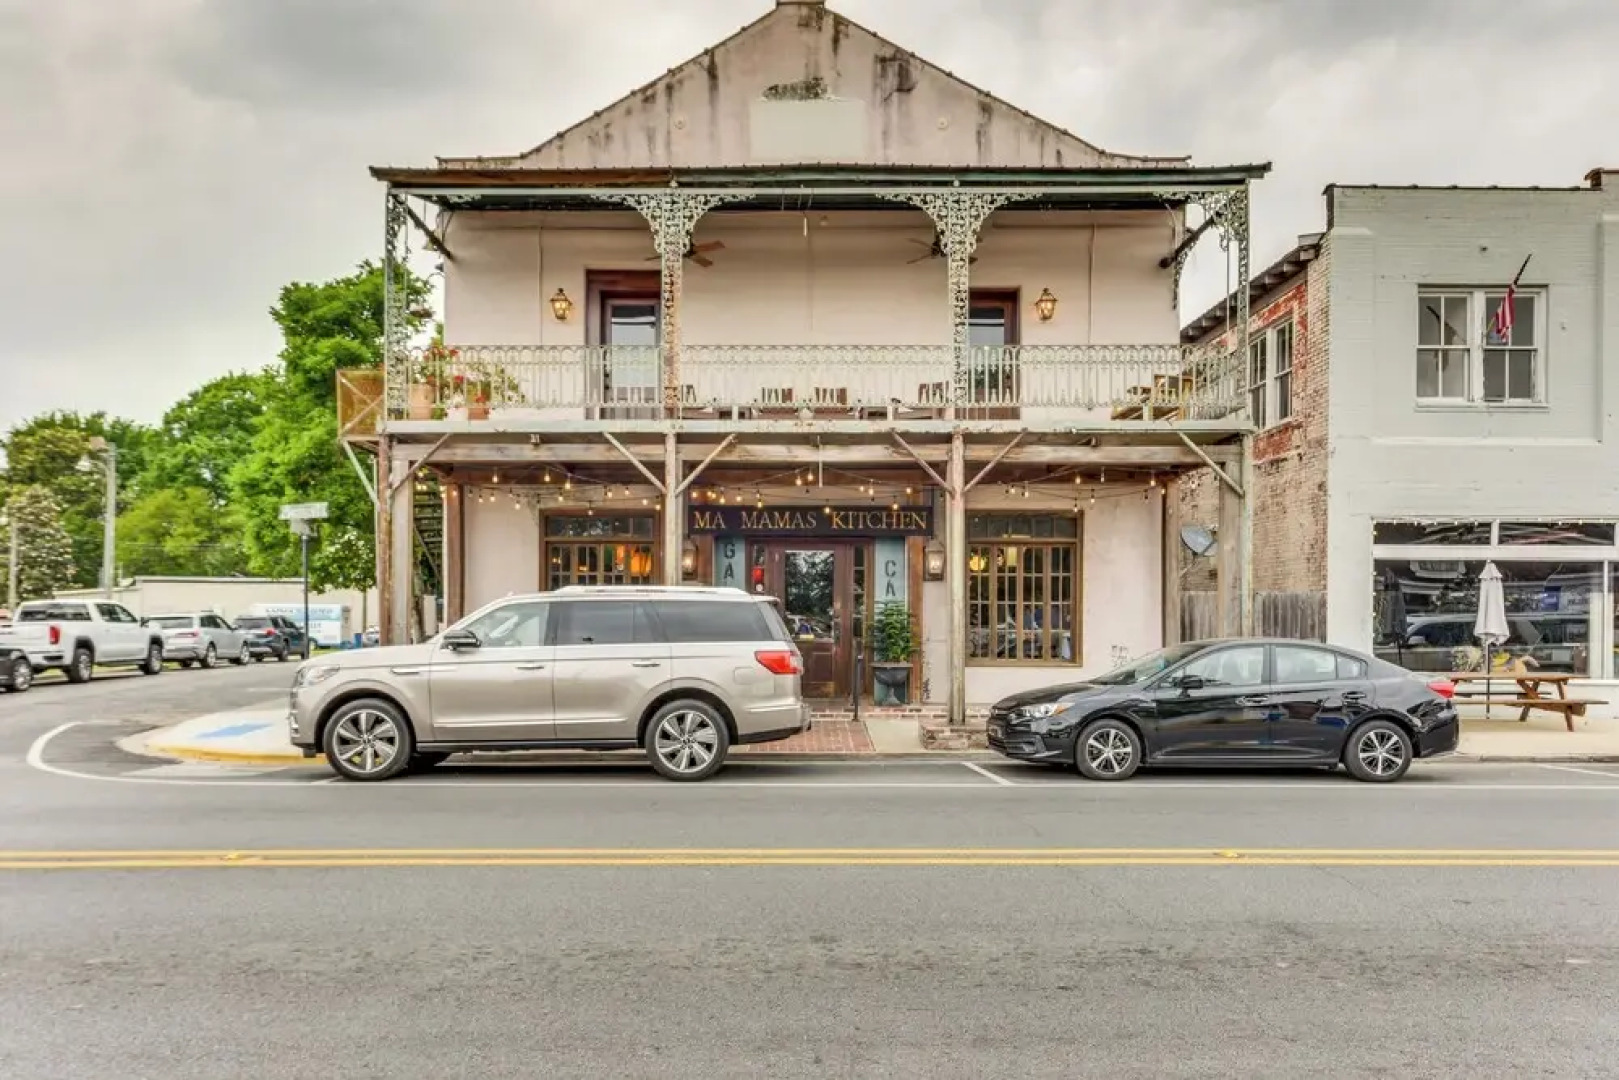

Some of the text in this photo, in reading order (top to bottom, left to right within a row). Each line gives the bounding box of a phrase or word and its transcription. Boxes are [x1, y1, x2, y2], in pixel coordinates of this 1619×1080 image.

[693, 511, 927, 529] MA MAMAS KITCHEN
